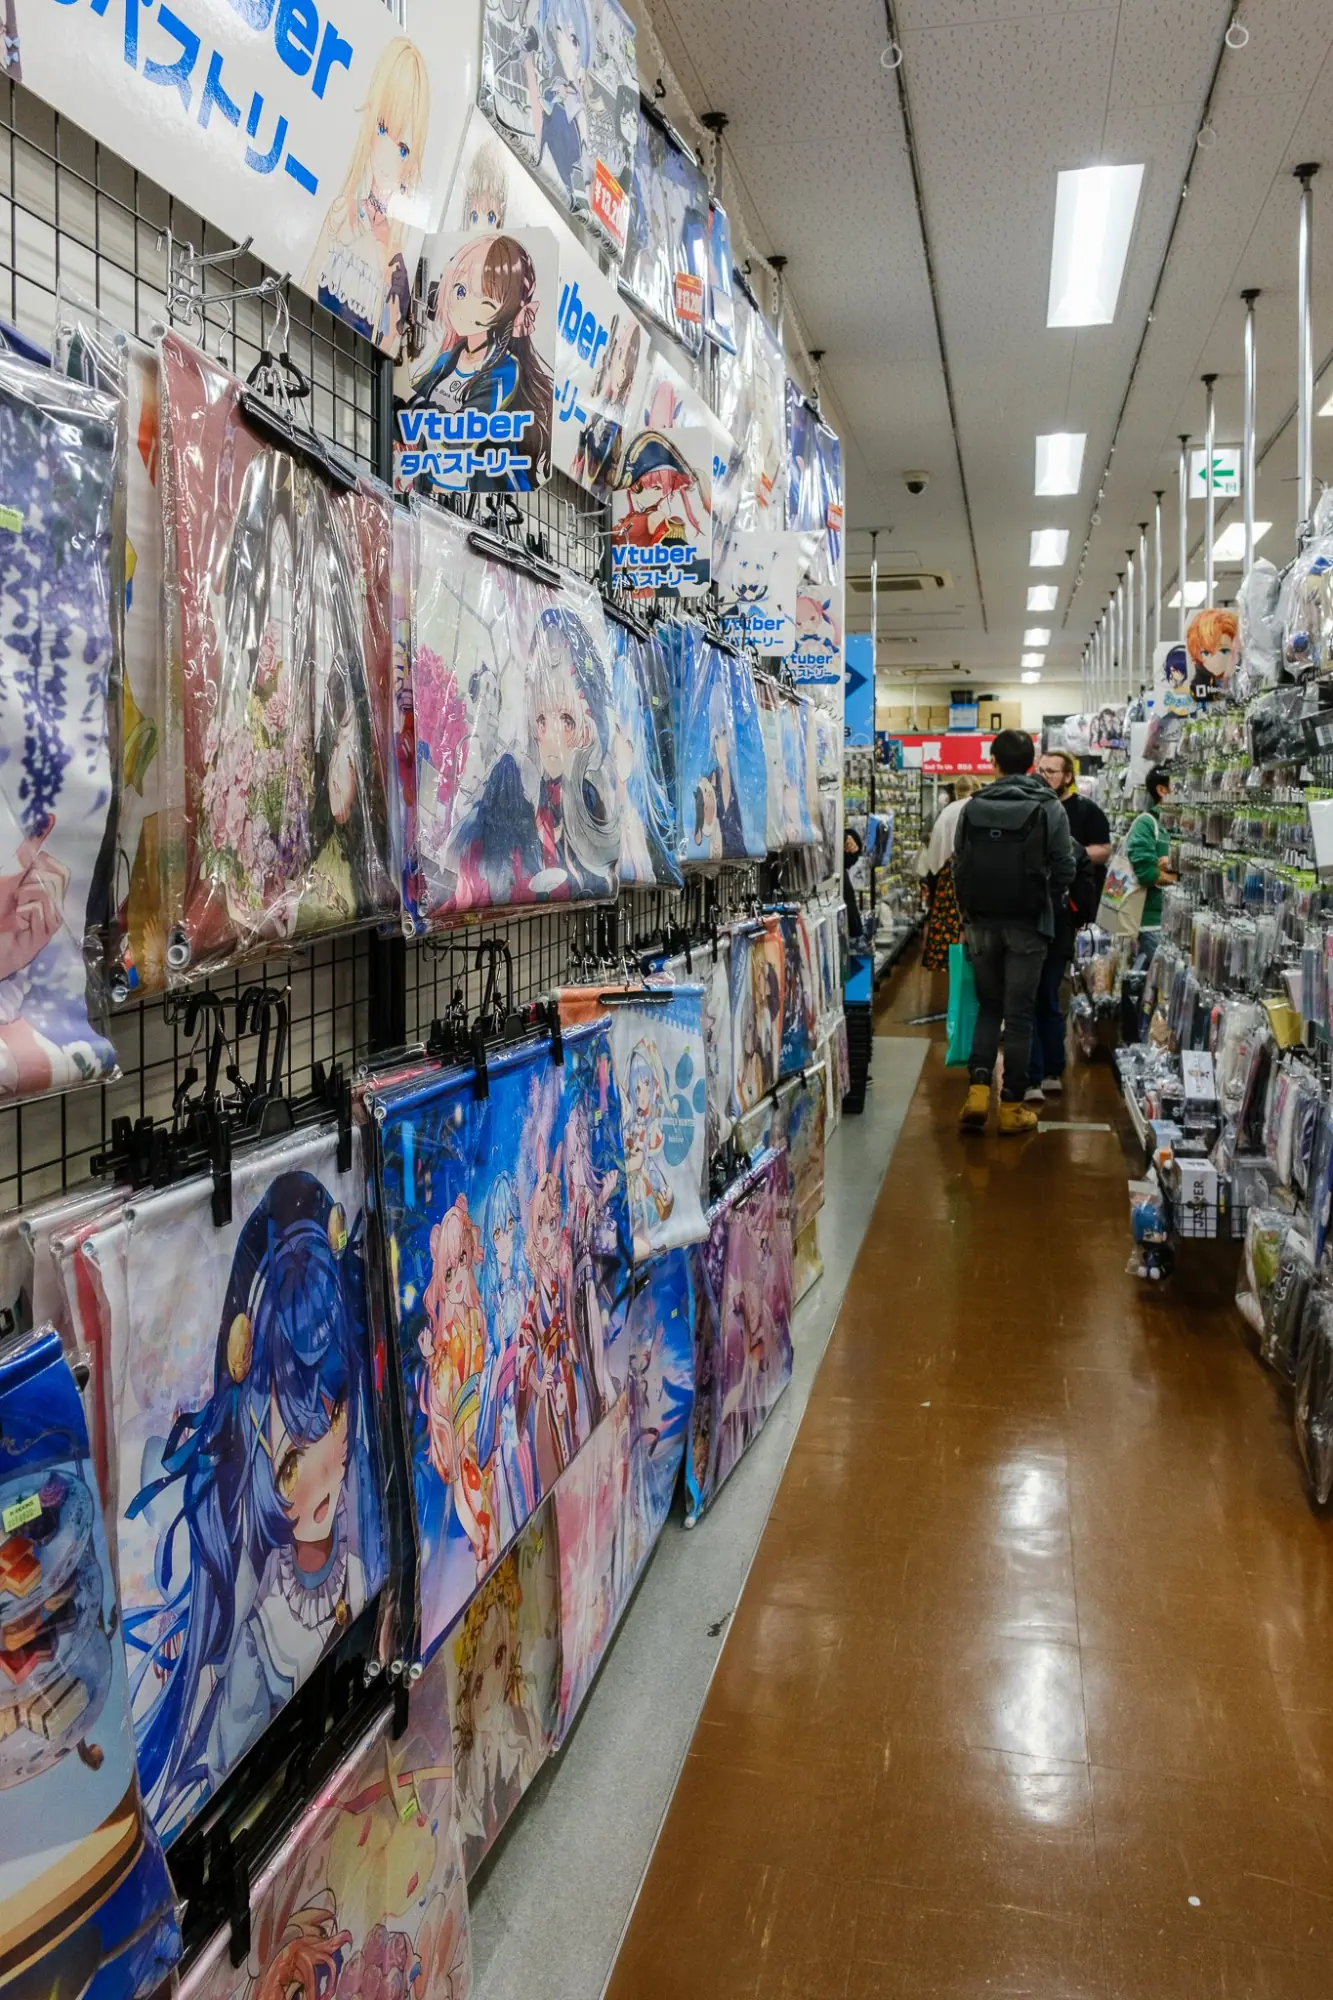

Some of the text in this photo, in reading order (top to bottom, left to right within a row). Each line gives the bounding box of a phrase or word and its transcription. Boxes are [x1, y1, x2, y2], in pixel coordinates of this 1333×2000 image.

[50, 0, 319, 195] ペストリー
[400, 411, 531, 440] Vtuber
[400, 451, 528, 476] タペストリー
[612, 545, 697, 565] Vtuber
